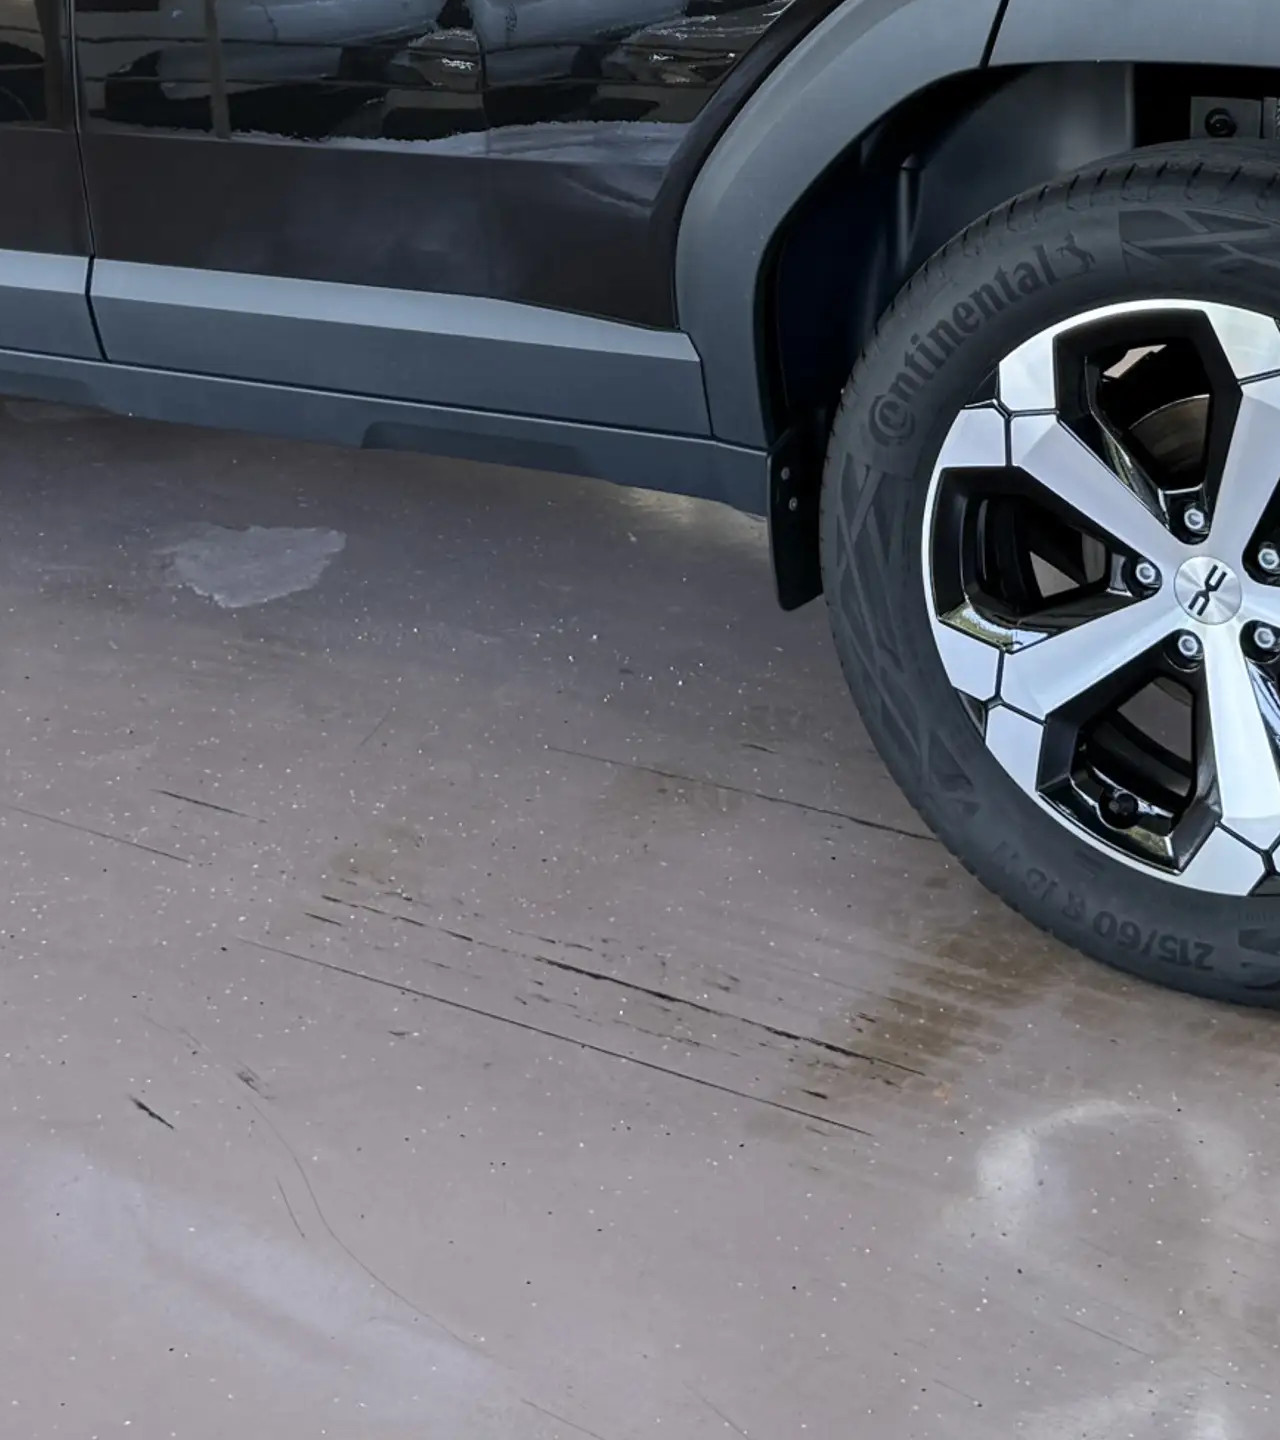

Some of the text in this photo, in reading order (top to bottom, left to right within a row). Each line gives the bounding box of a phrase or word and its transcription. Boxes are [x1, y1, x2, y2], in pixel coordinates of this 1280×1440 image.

[867, 243, 1061, 448] Continental
[1061, 891, 1088, 922] R
[1092, 910, 1215, 971] 215/60
